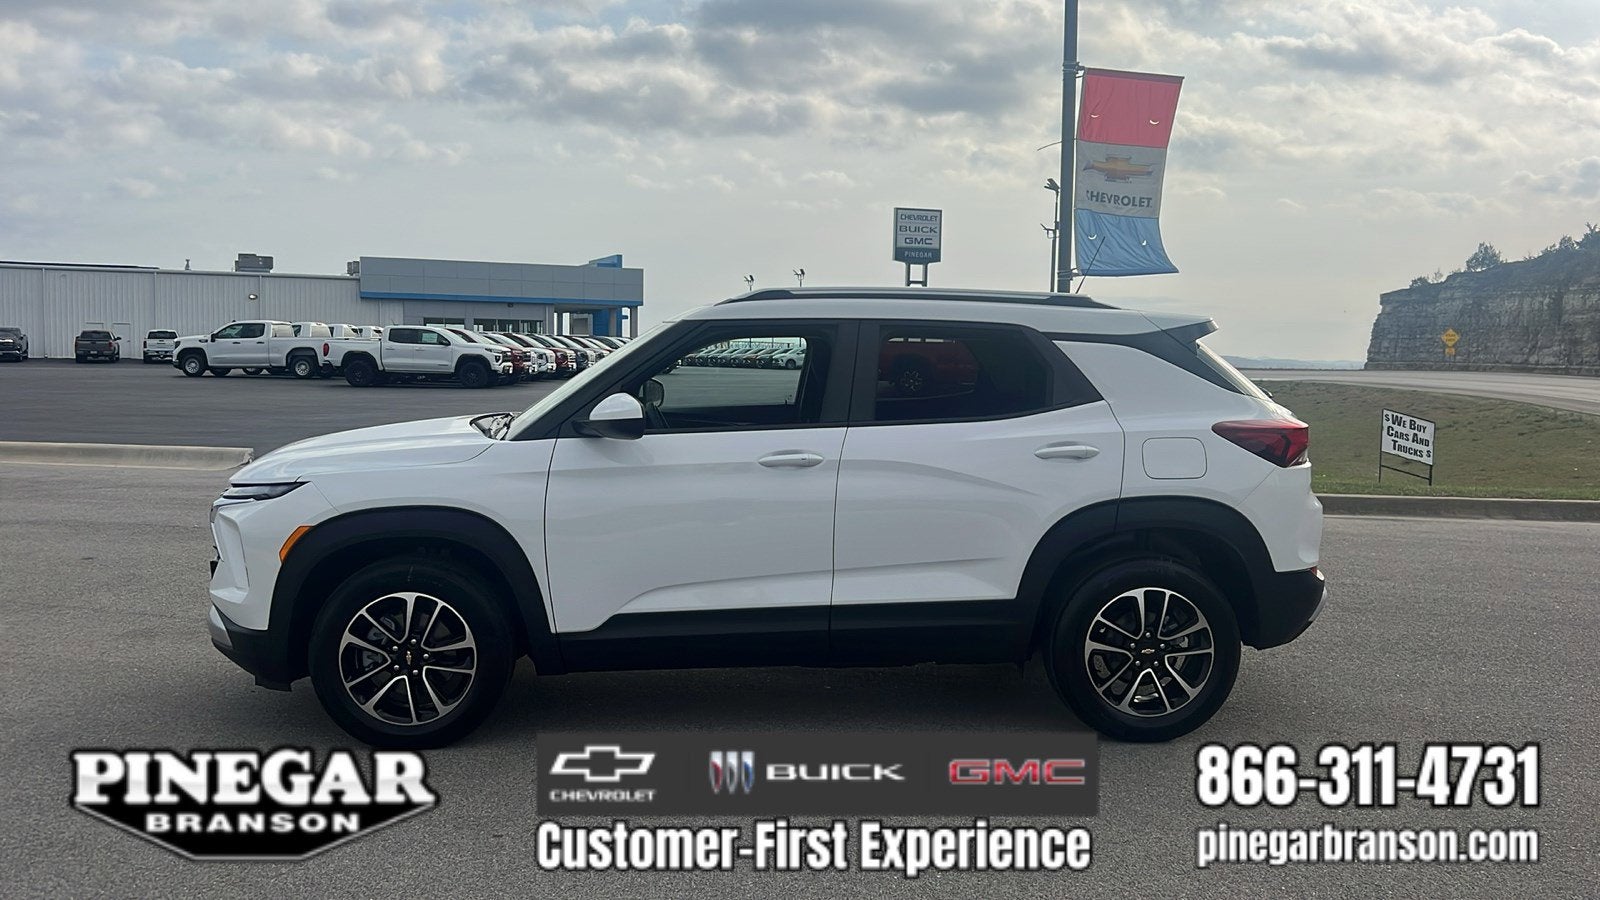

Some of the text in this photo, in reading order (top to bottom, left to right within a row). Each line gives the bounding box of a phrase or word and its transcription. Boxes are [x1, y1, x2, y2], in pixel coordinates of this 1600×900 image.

[900, 213, 939, 222] CHEVROLET
[899, 225, 938, 234] BUICK
[904, 237, 933, 245] GMC
[904, 250, 933, 259] PINEGAR
